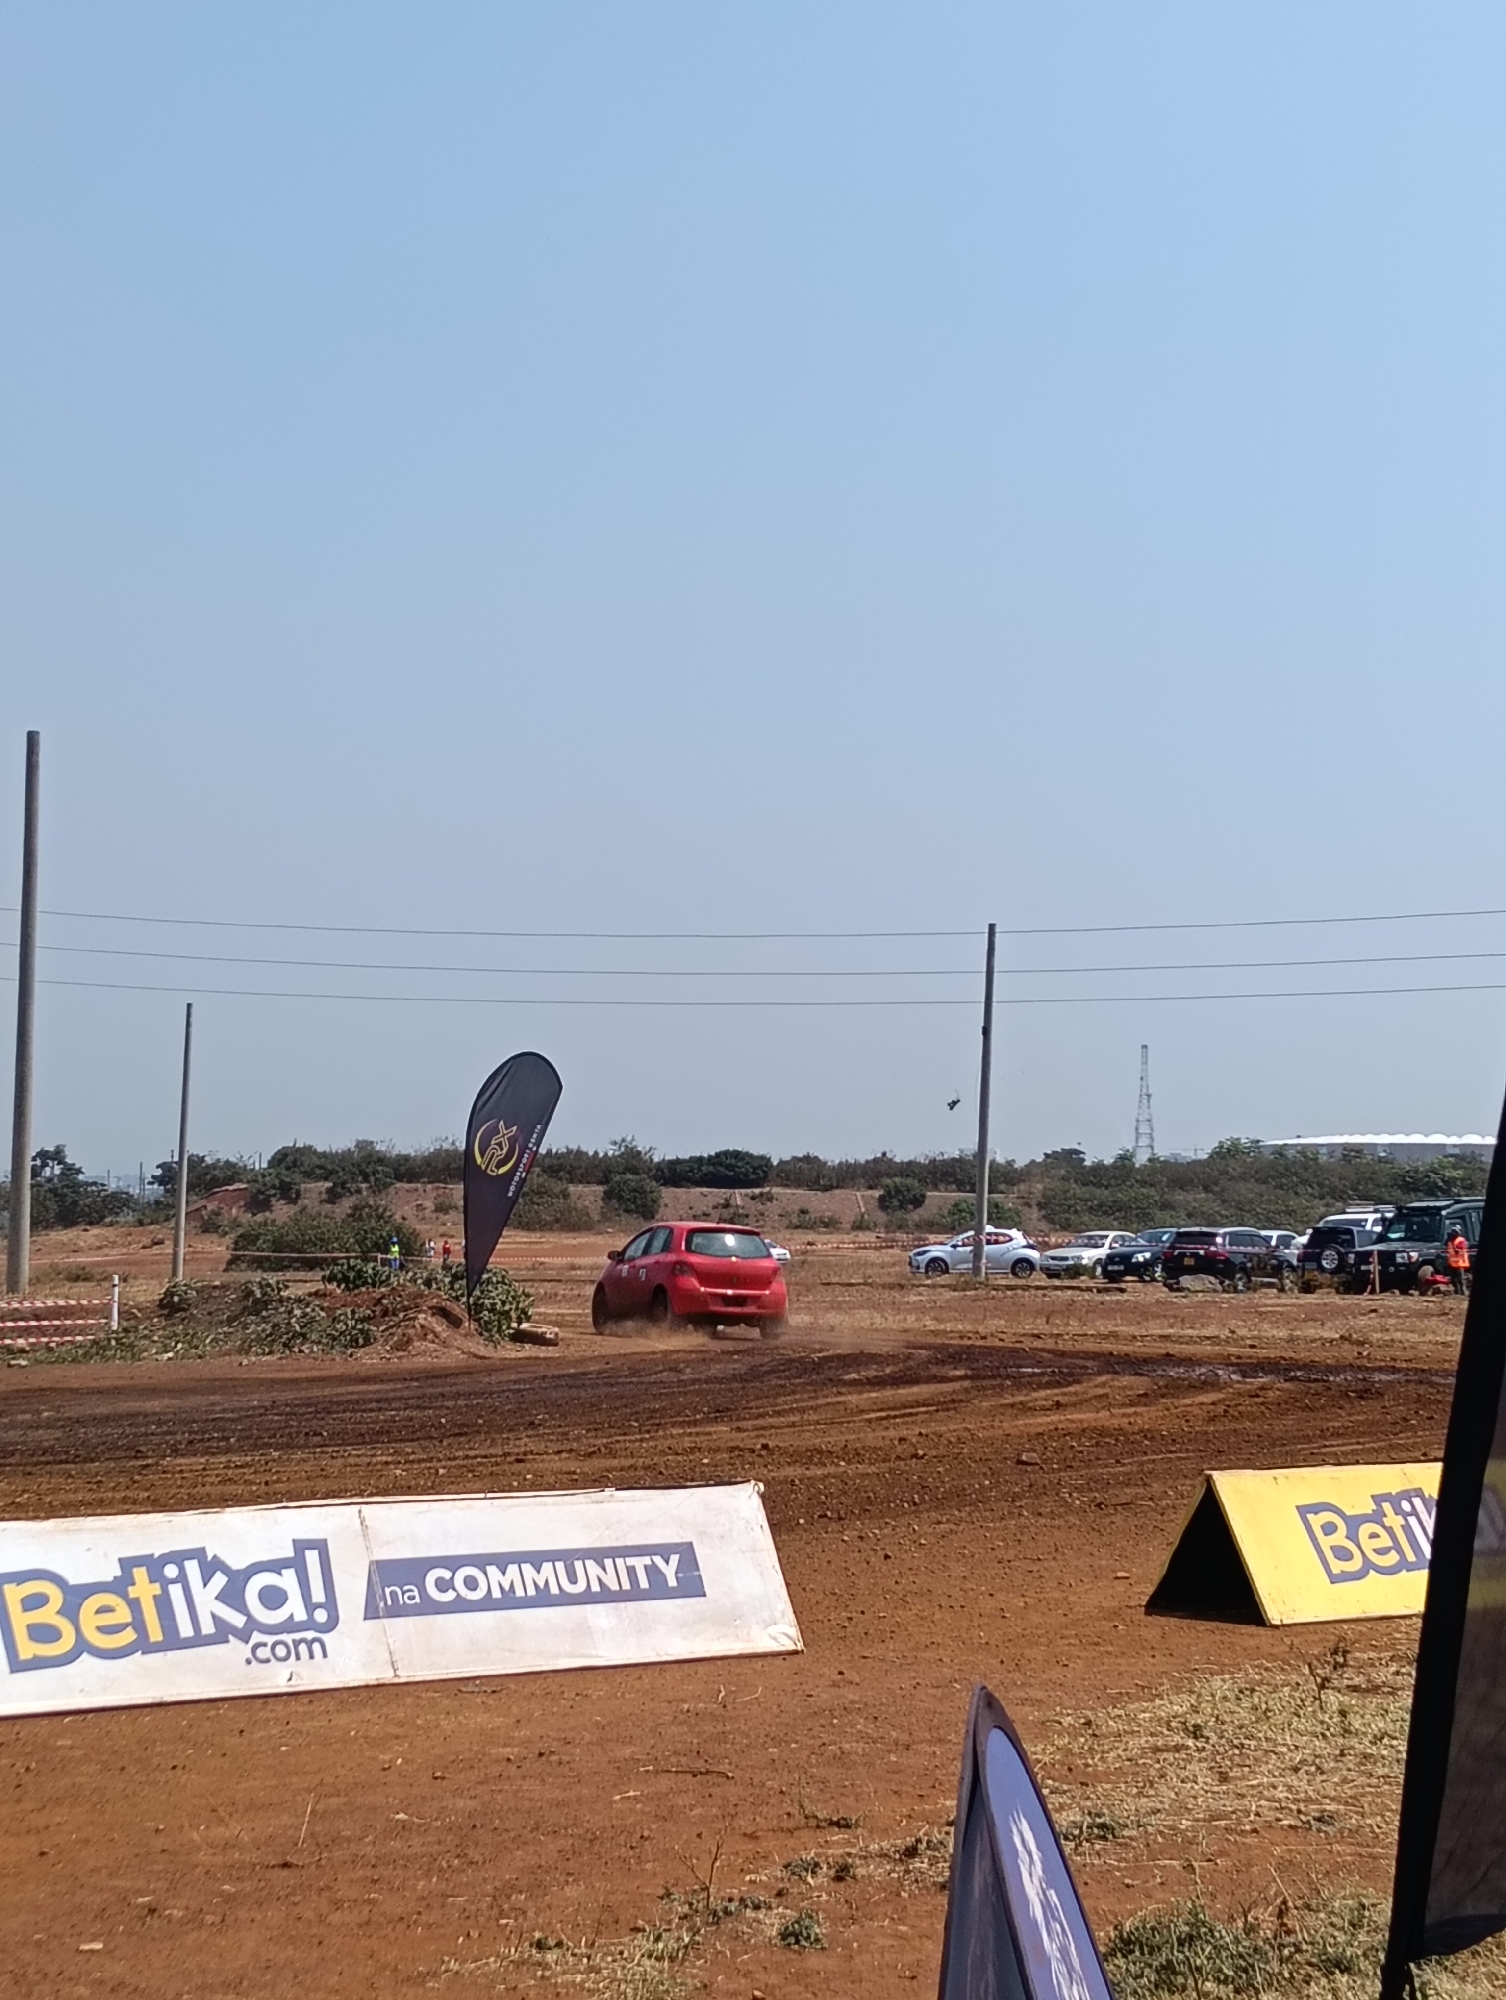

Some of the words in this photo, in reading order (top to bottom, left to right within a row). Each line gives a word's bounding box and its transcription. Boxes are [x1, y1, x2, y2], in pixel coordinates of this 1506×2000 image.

[3, 1549, 328, 1661] Betika!
[384, 1583, 421, 1606] na
[424, 1553, 680, 1602] COMMUNITY
[245, 1636, 328, 1665] .com
